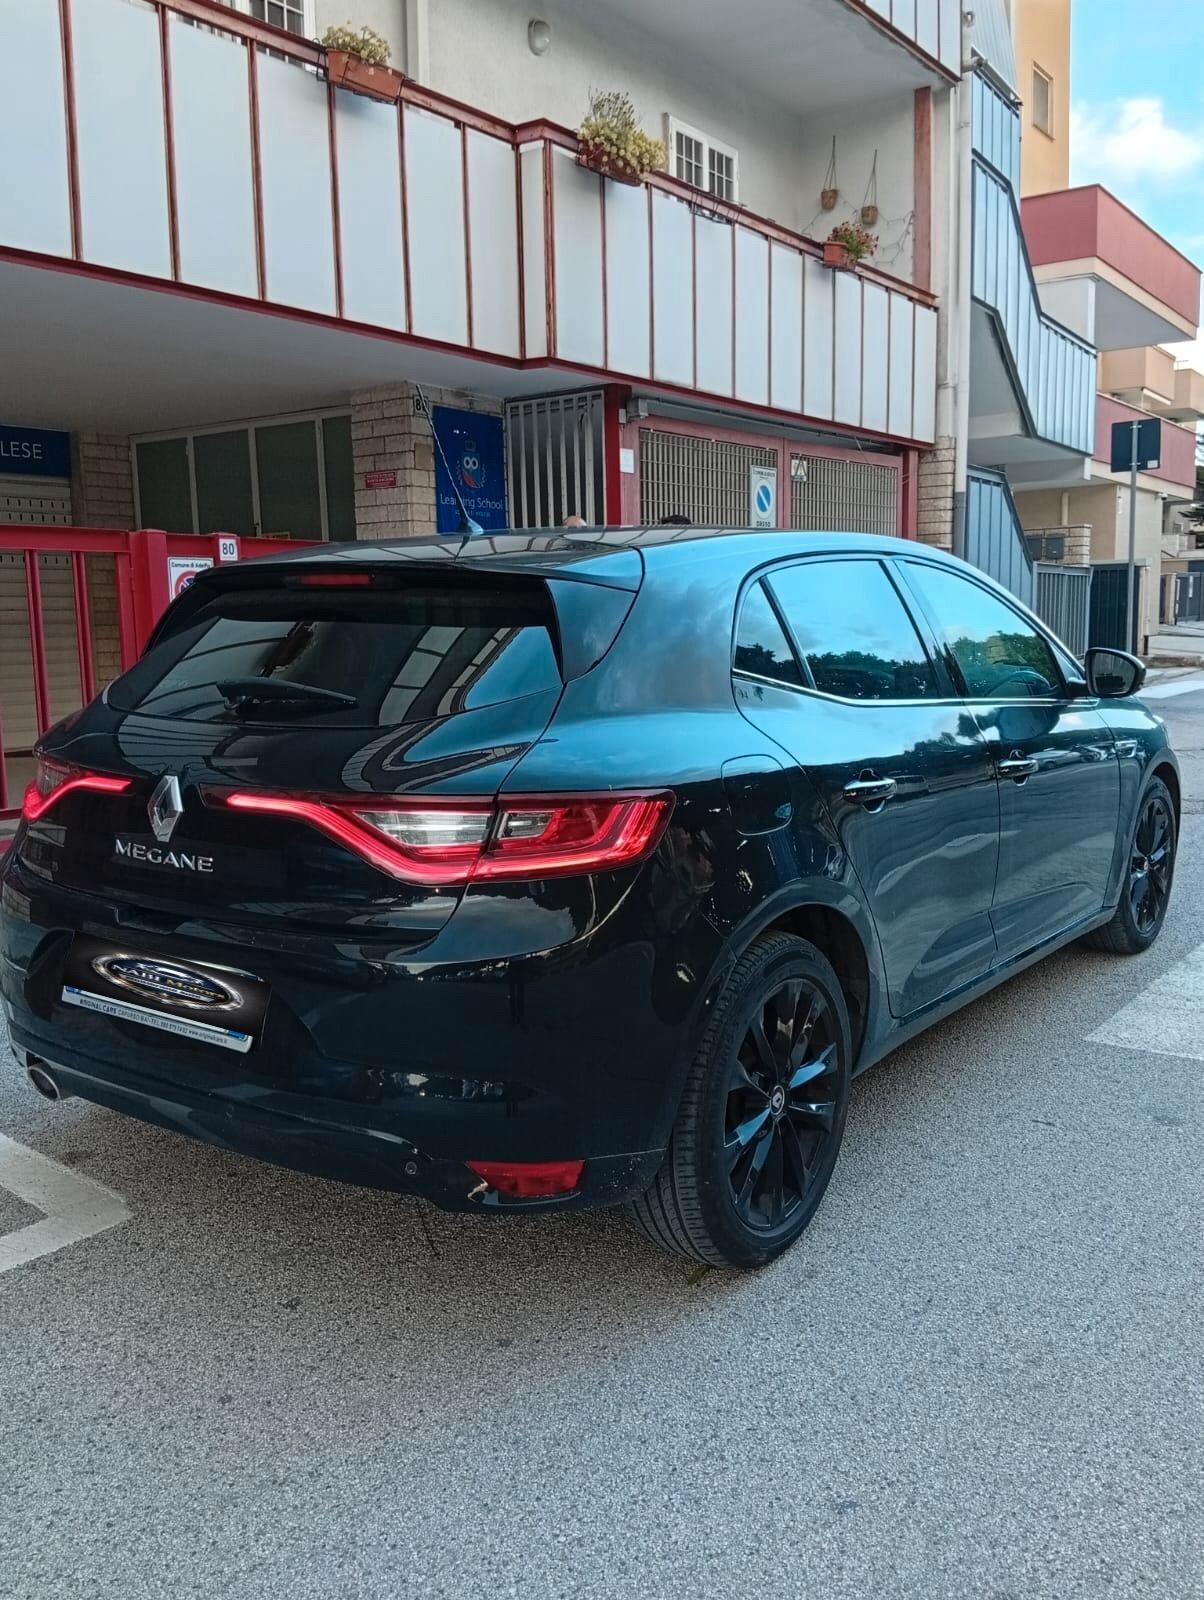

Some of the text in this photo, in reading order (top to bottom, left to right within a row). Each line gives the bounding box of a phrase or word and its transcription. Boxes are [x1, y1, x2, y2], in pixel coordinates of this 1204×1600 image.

[0, 440, 43, 459] LESE
[440, 493, 503, 510] Learing School
[222, 543, 235, 556] 80
[115, 838, 214, 873] MEGANE
[102, 1003, 117, 1014] CARS
